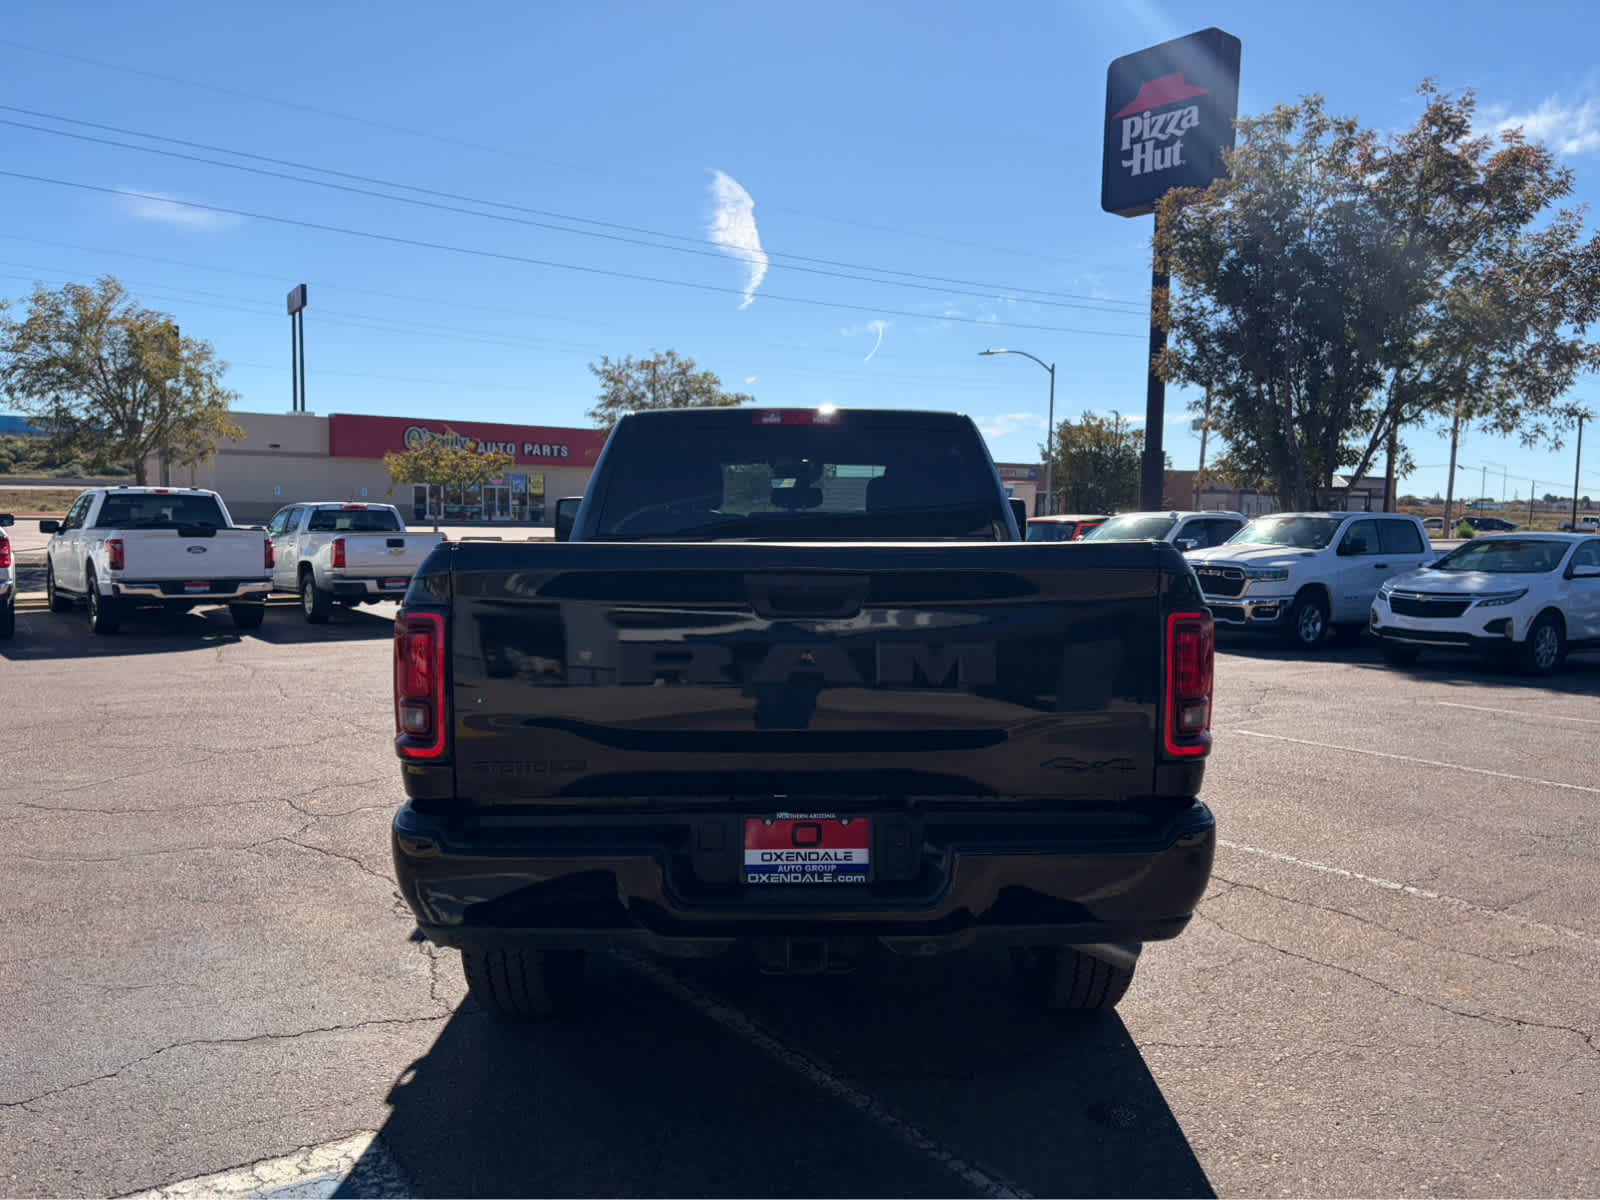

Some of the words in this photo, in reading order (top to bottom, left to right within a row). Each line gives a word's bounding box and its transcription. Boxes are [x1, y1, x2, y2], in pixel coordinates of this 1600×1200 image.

[1121, 105, 1200, 151] Pizza
[1121, 140, 1184, 176] Hut
[478, 441, 516, 457] AUTO
[524, 443, 569, 457] PARTS
[617, 641, 998, 686] RAM
[761, 851, 854, 863] OXENDALE
[777, 865, 803, 873] AUTO
[804, 864, 838, 872] GROUP
[747, 873, 866, 884] OXENDALE.com
